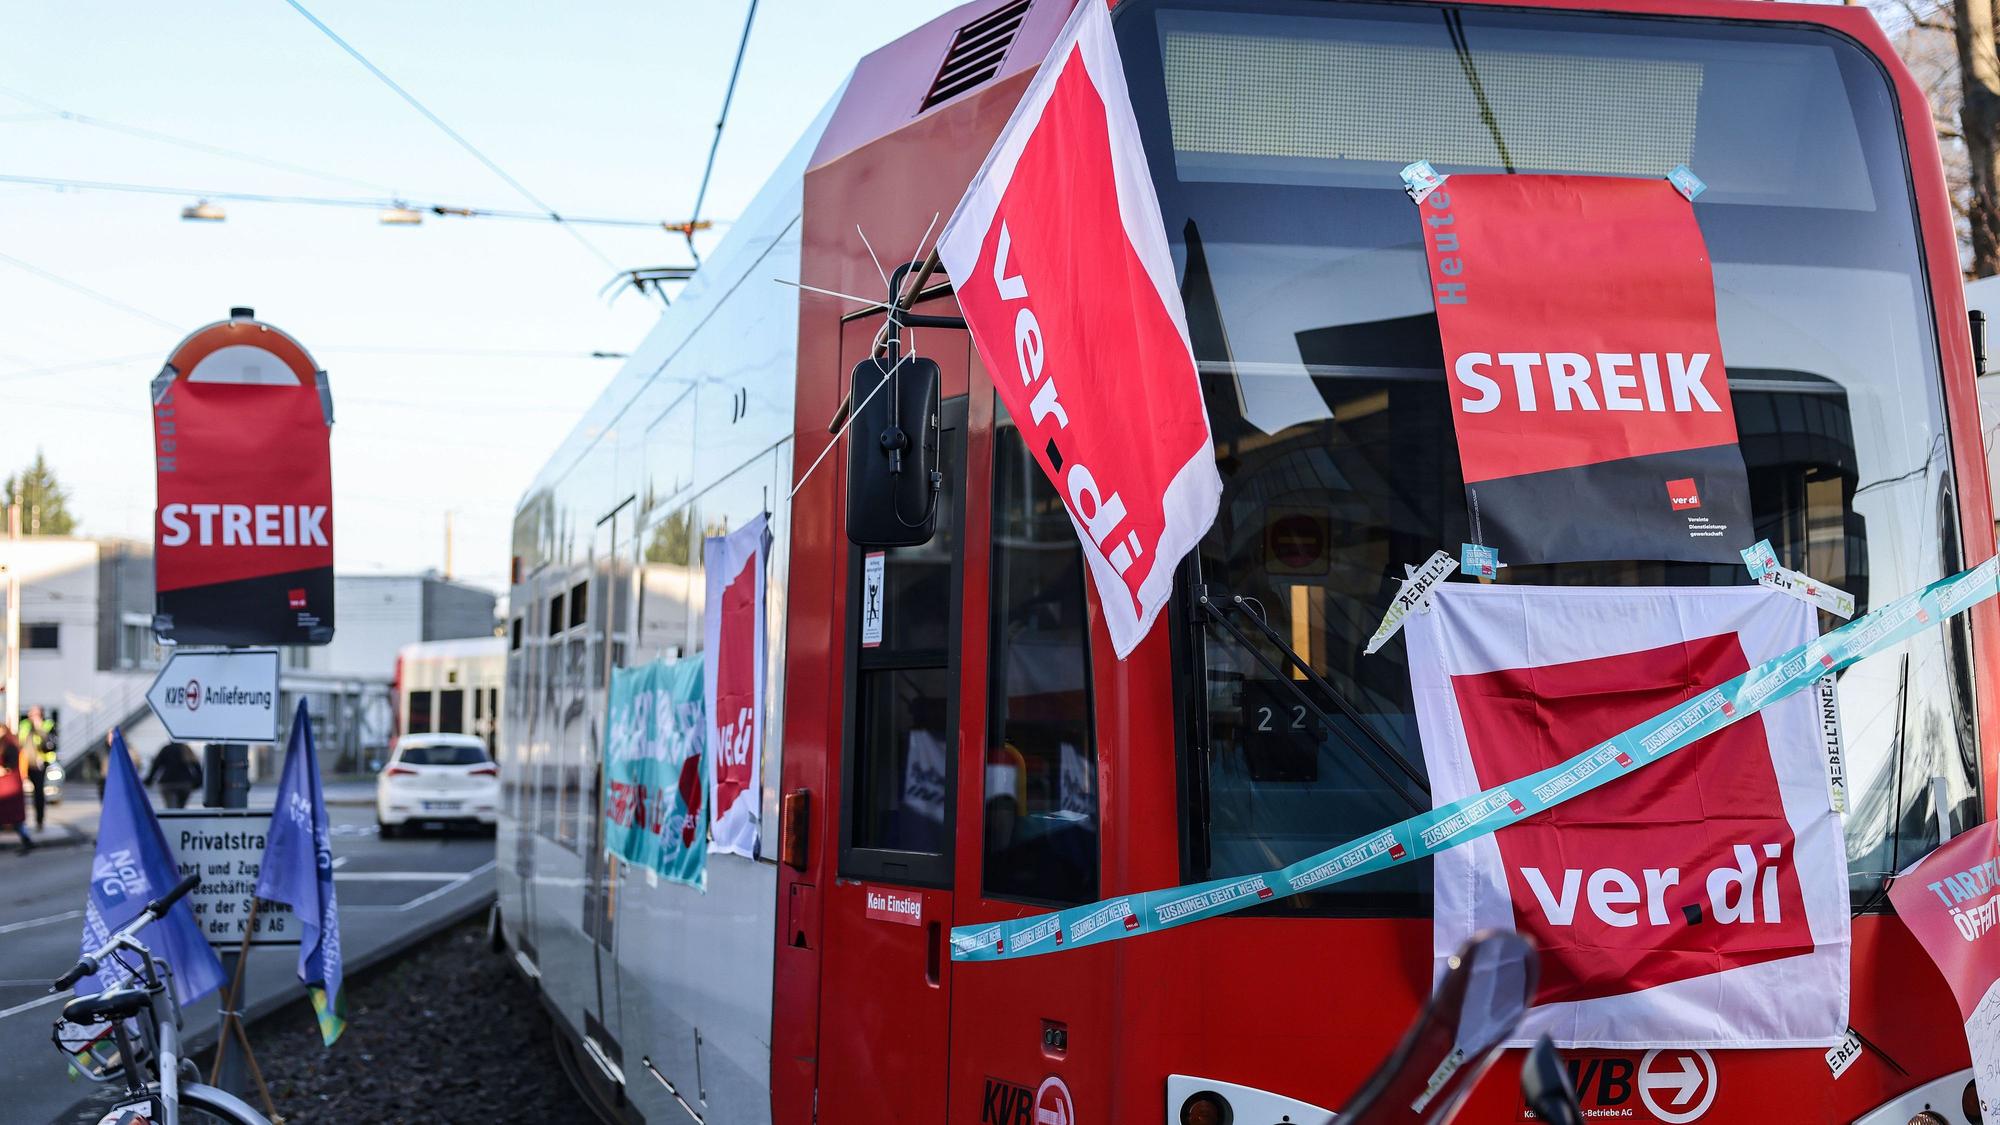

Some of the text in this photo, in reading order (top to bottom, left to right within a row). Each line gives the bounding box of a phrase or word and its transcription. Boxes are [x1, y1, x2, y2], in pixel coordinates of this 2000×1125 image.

[993, 218, 1143, 578] ver.di
[1454, 352, 1723, 414] STREIK
[161, 503, 329, 547] STREIK
[204, 686, 271, 710] Anlieferung
[1535, 773, 1577, 801] ZUSAMMEN
[1576, 759, 1598, 781] GEHT
[1599, 744, 1621, 767] MEHR
[181, 830, 265, 850] Privatstra
[1422, 789, 1514, 847] ZUSAMMEN GEHT MEHR
[208, 862, 230, 875] und
[238, 861, 259, 878] Zug
[1290, 834, 1397, 890] ZUSAMMEN GEHT MEHR
[215, 900, 235, 913] der
[868, 892, 921, 920] Kein Einstieg
[1156, 878, 1266, 923] ZUSAMMEN GEHT MEHR
[1519, 843, 1782, 927] ver.di
[209, 919, 229, 933] der
[237, 919, 260, 933] KB
[268, 918, 284, 932] AG
[982, 1079, 1034, 1125] KVB
[1621, 1108, 1633, 1117] AG
